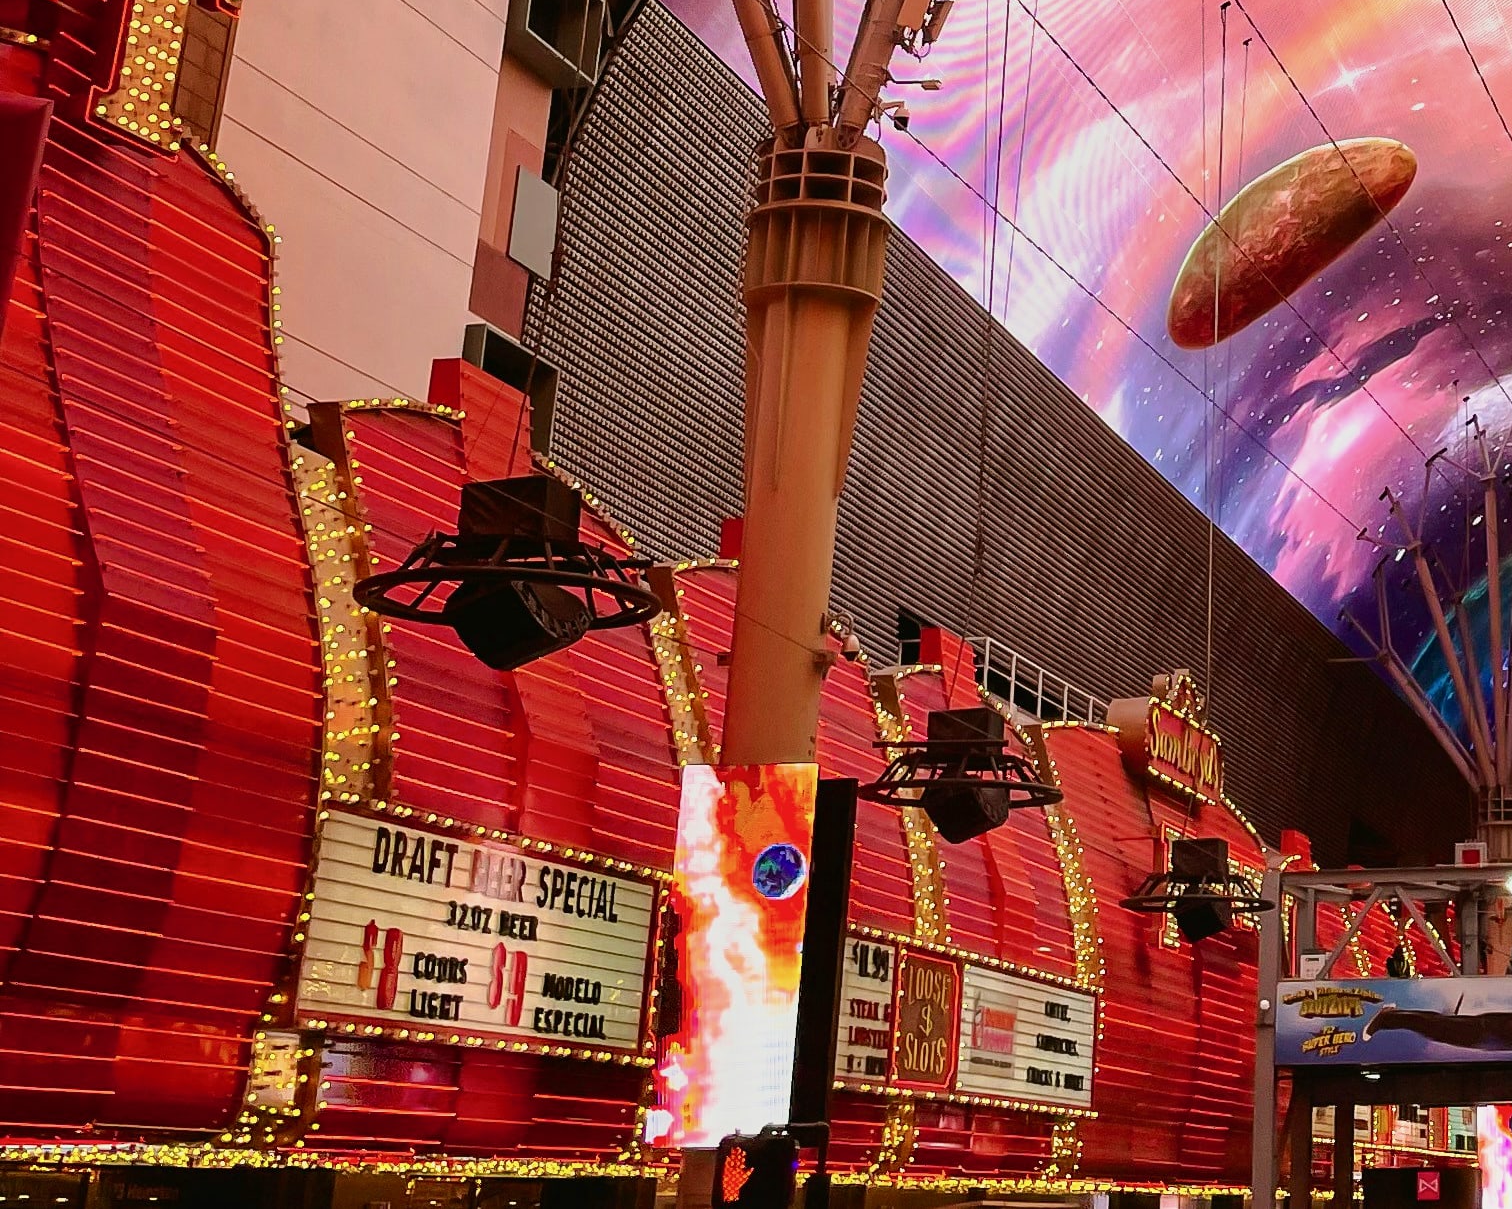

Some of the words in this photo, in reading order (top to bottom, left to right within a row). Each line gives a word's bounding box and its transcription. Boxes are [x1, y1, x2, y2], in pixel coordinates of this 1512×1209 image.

[372, 826, 459, 889] DRAFT
[536, 865, 619, 924] SPECIAL
[499, 910, 540, 942] BEER
[413, 951, 469, 985] COORS
[409, 988, 464, 1022] LIGHT
[543, 972, 603, 1007] MODELO
[907, 964, 951, 1012] LOOSE
[533, 1007, 607, 1041] ESPECIAL
[903, 1032, 947, 1075] SLOTS
